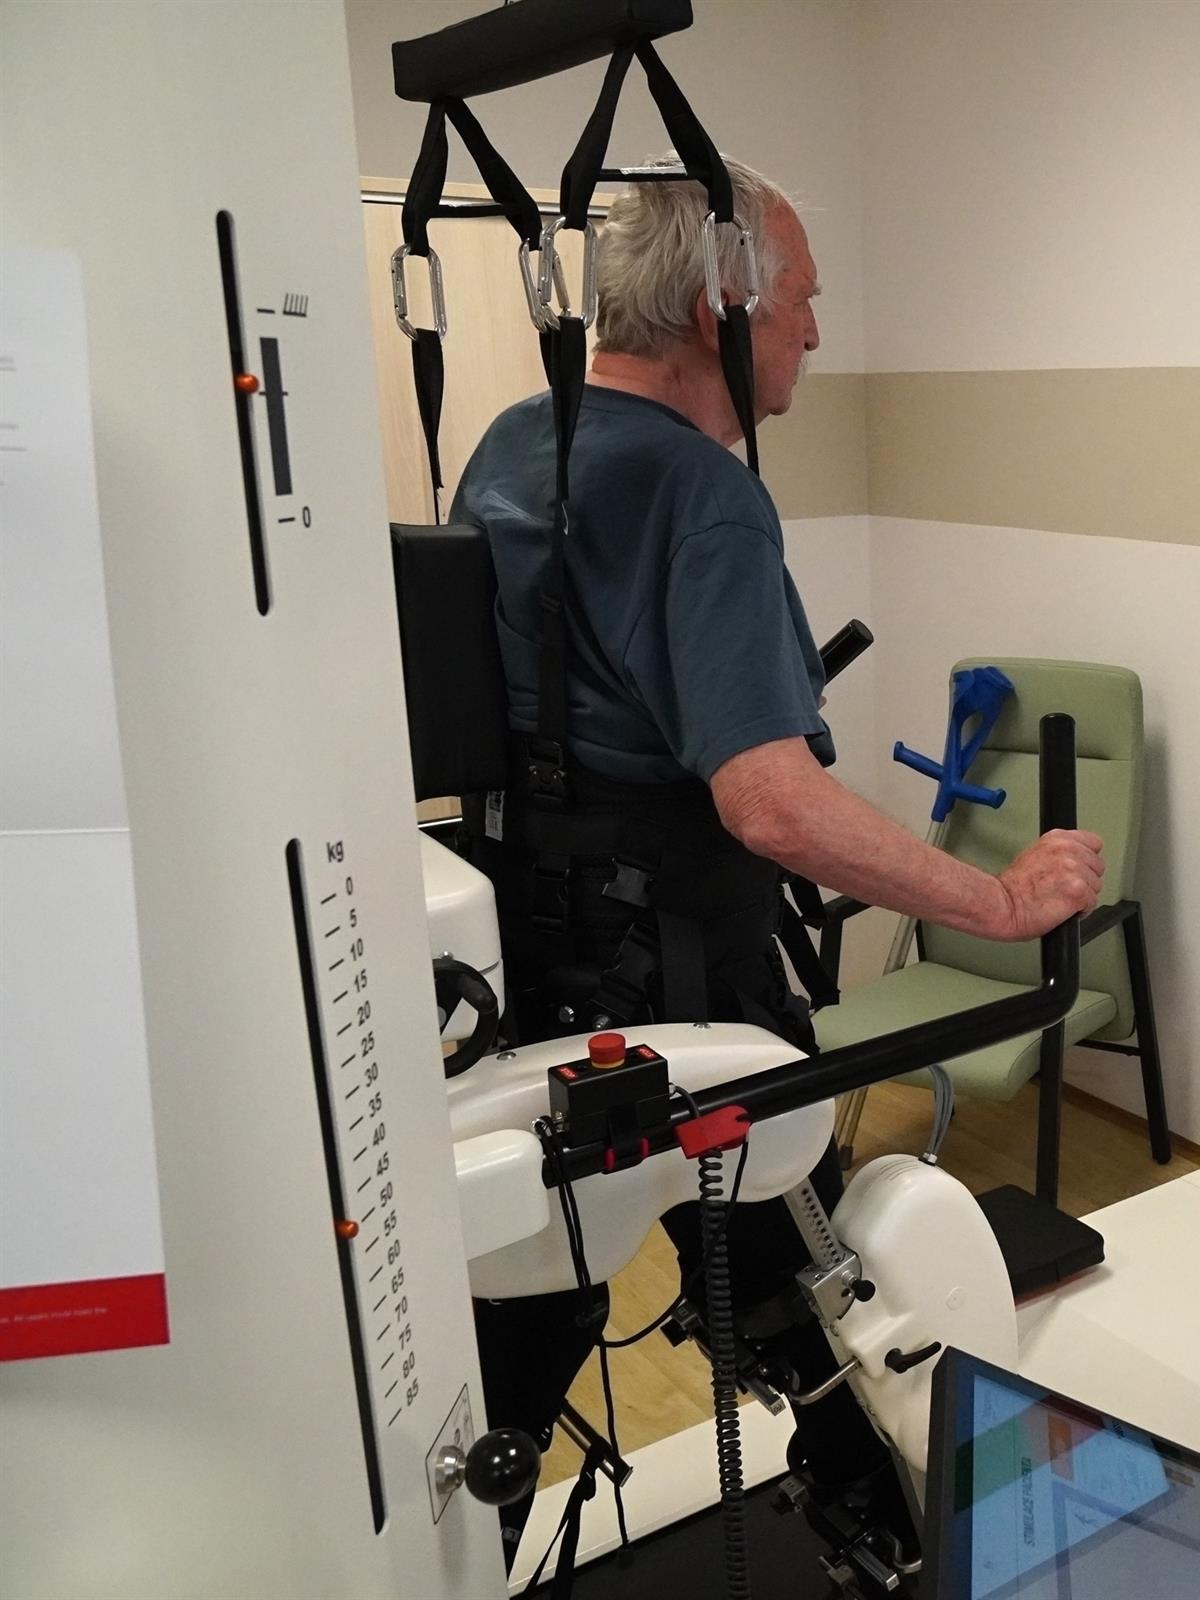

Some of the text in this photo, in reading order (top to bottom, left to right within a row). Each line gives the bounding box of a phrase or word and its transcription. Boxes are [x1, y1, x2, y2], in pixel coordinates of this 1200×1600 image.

[302, 506, 311, 528] 0
[326, 840, 344, 863] kg
[345, 876, 354, 896] 0
[349, 908, 358, 928] 5
[350, 938, 364, 962] 10
[354, 969, 368, 993] 15
[357, 1000, 371, 1028] 20
[361, 1030, 375, 1058] 25
[365, 1061, 379, 1088] 30
[368, 1091, 382, 1119] 35
[373, 1122, 386, 1147] 40
[376, 1151, 390, 1177] 45
[380, 1181, 393, 1208] 50
[384, 1210, 397, 1237] 55
[388, 1239, 401, 1266] 60
[391, 1267, 404, 1294] 65
[394, 1296, 408, 1323] 70
[398, 1323, 412, 1350] 75
[402, 1351, 415, 1379] 80
[406, 1378, 419, 1406] 85
